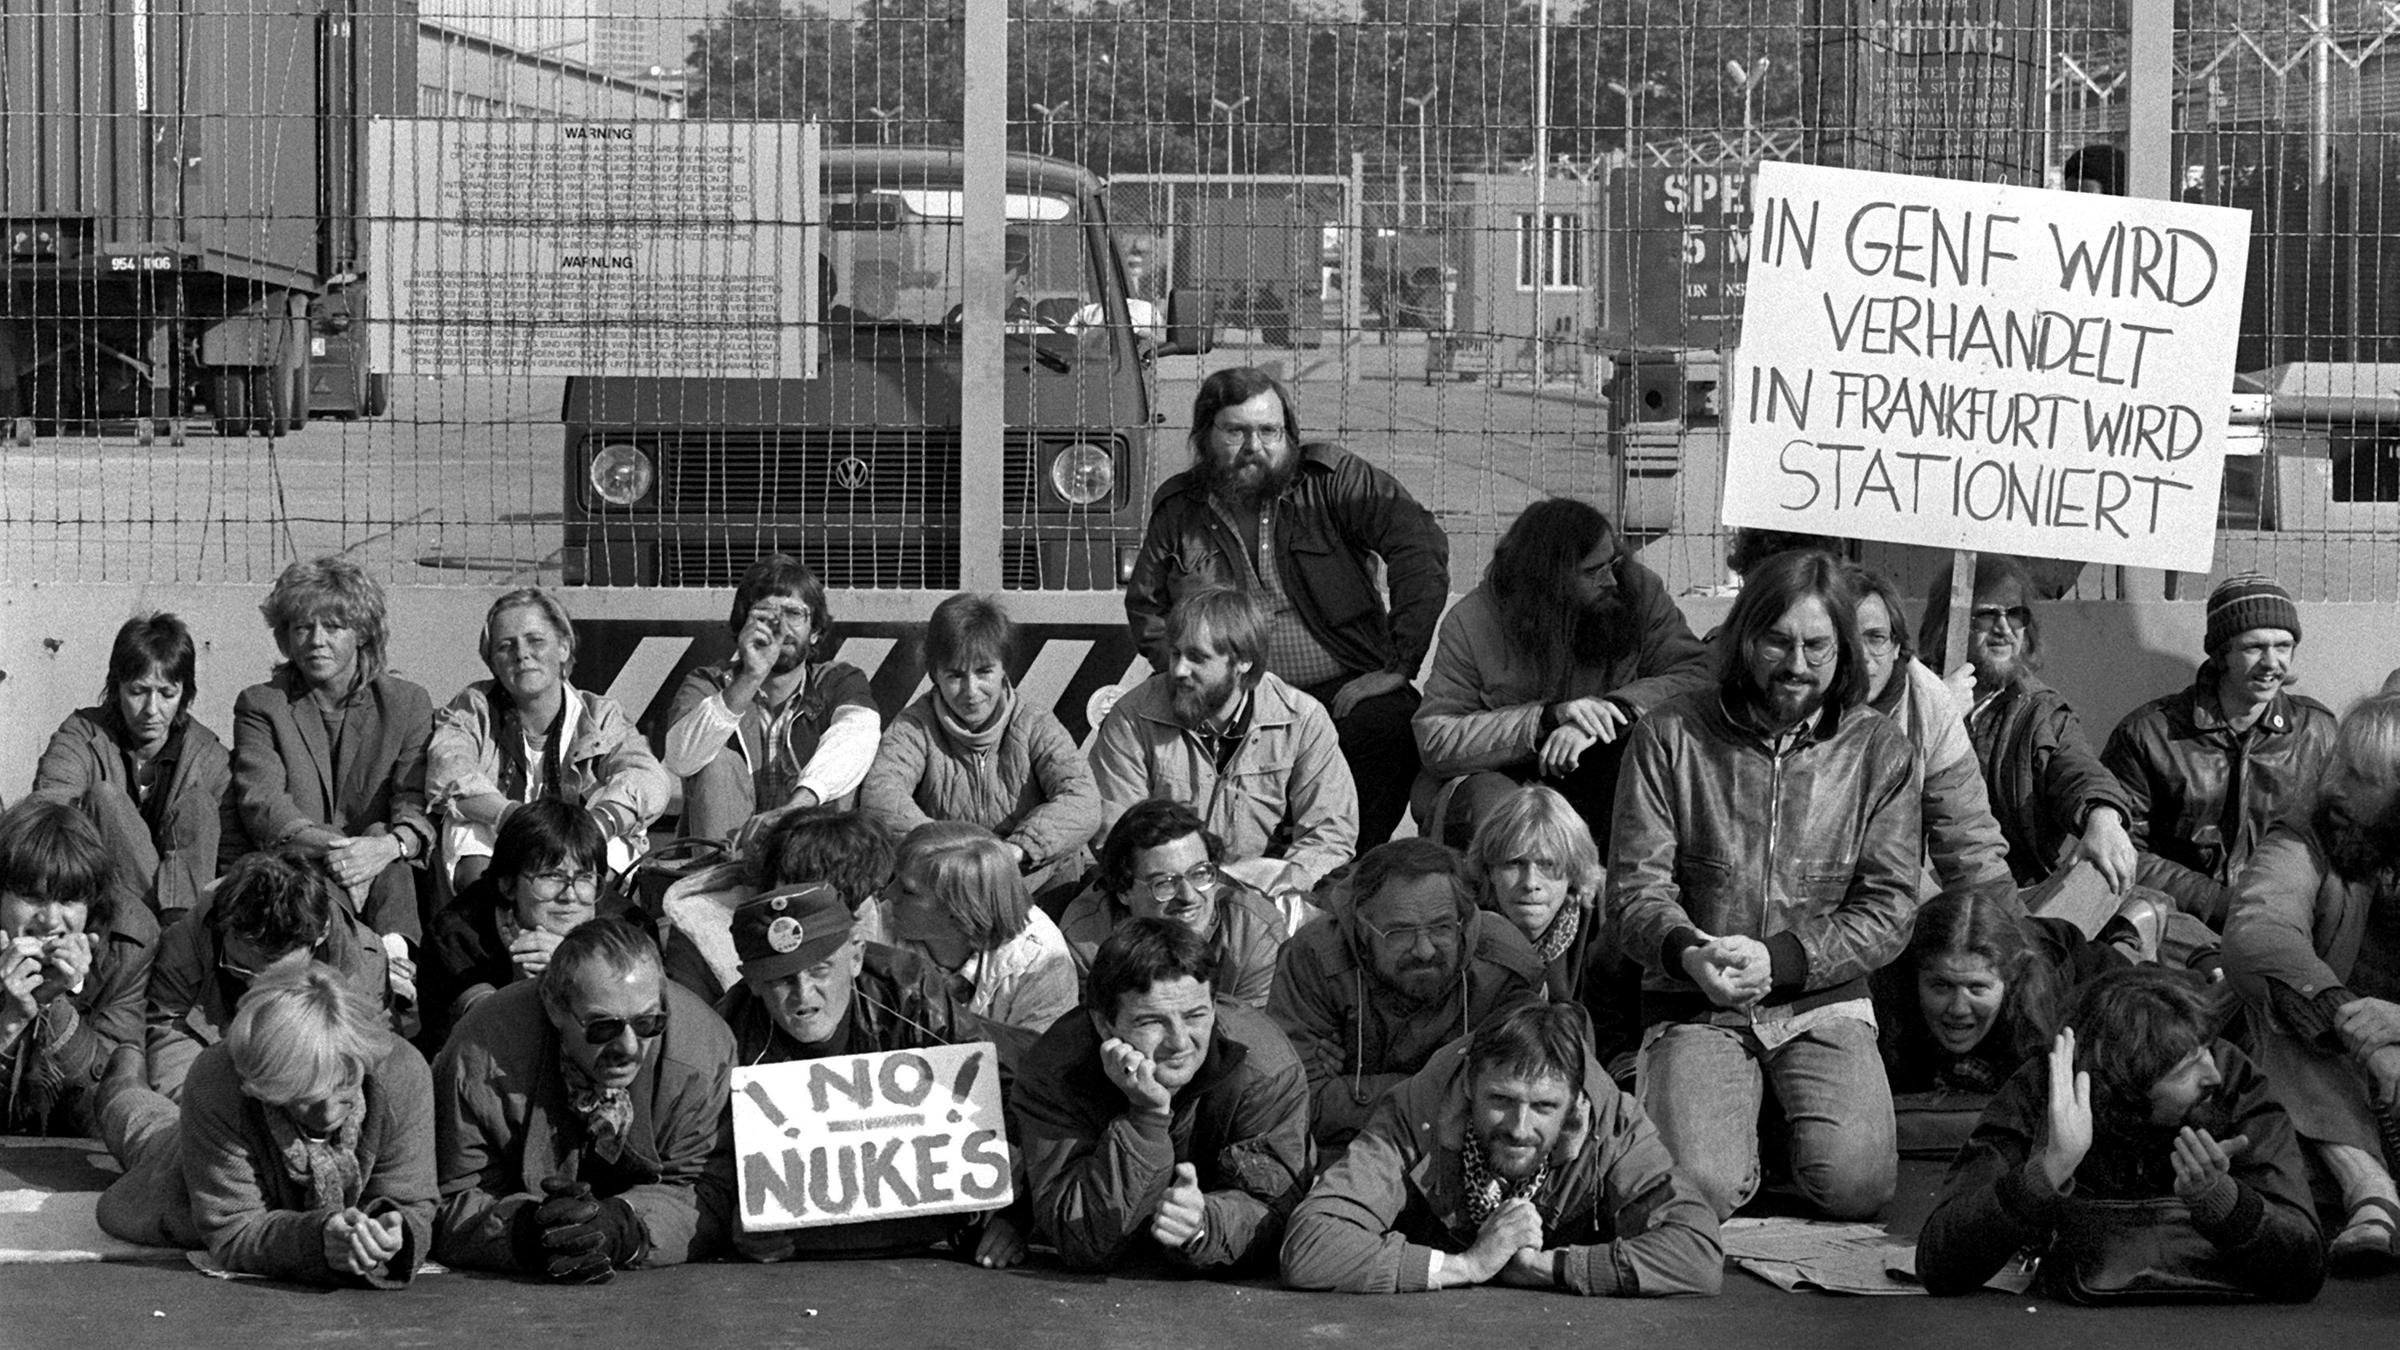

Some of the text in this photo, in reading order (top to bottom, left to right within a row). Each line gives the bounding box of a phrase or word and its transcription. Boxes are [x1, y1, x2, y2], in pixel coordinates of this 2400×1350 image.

[565, 127, 632, 139] WARNING
[112, 257, 135, 271] 954
[1684, 224, 1706, 264] 5
[1760, 198, 2218, 307] IN GENF WIRD
[1822, 292, 2174, 389] VERHANDELT
[1750, 366, 2202, 462] IN FRANKFURT WIRD
[1780, 440, 2193, 538] STATIONIERT
[743, 1129, 1011, 1218] NUKES
